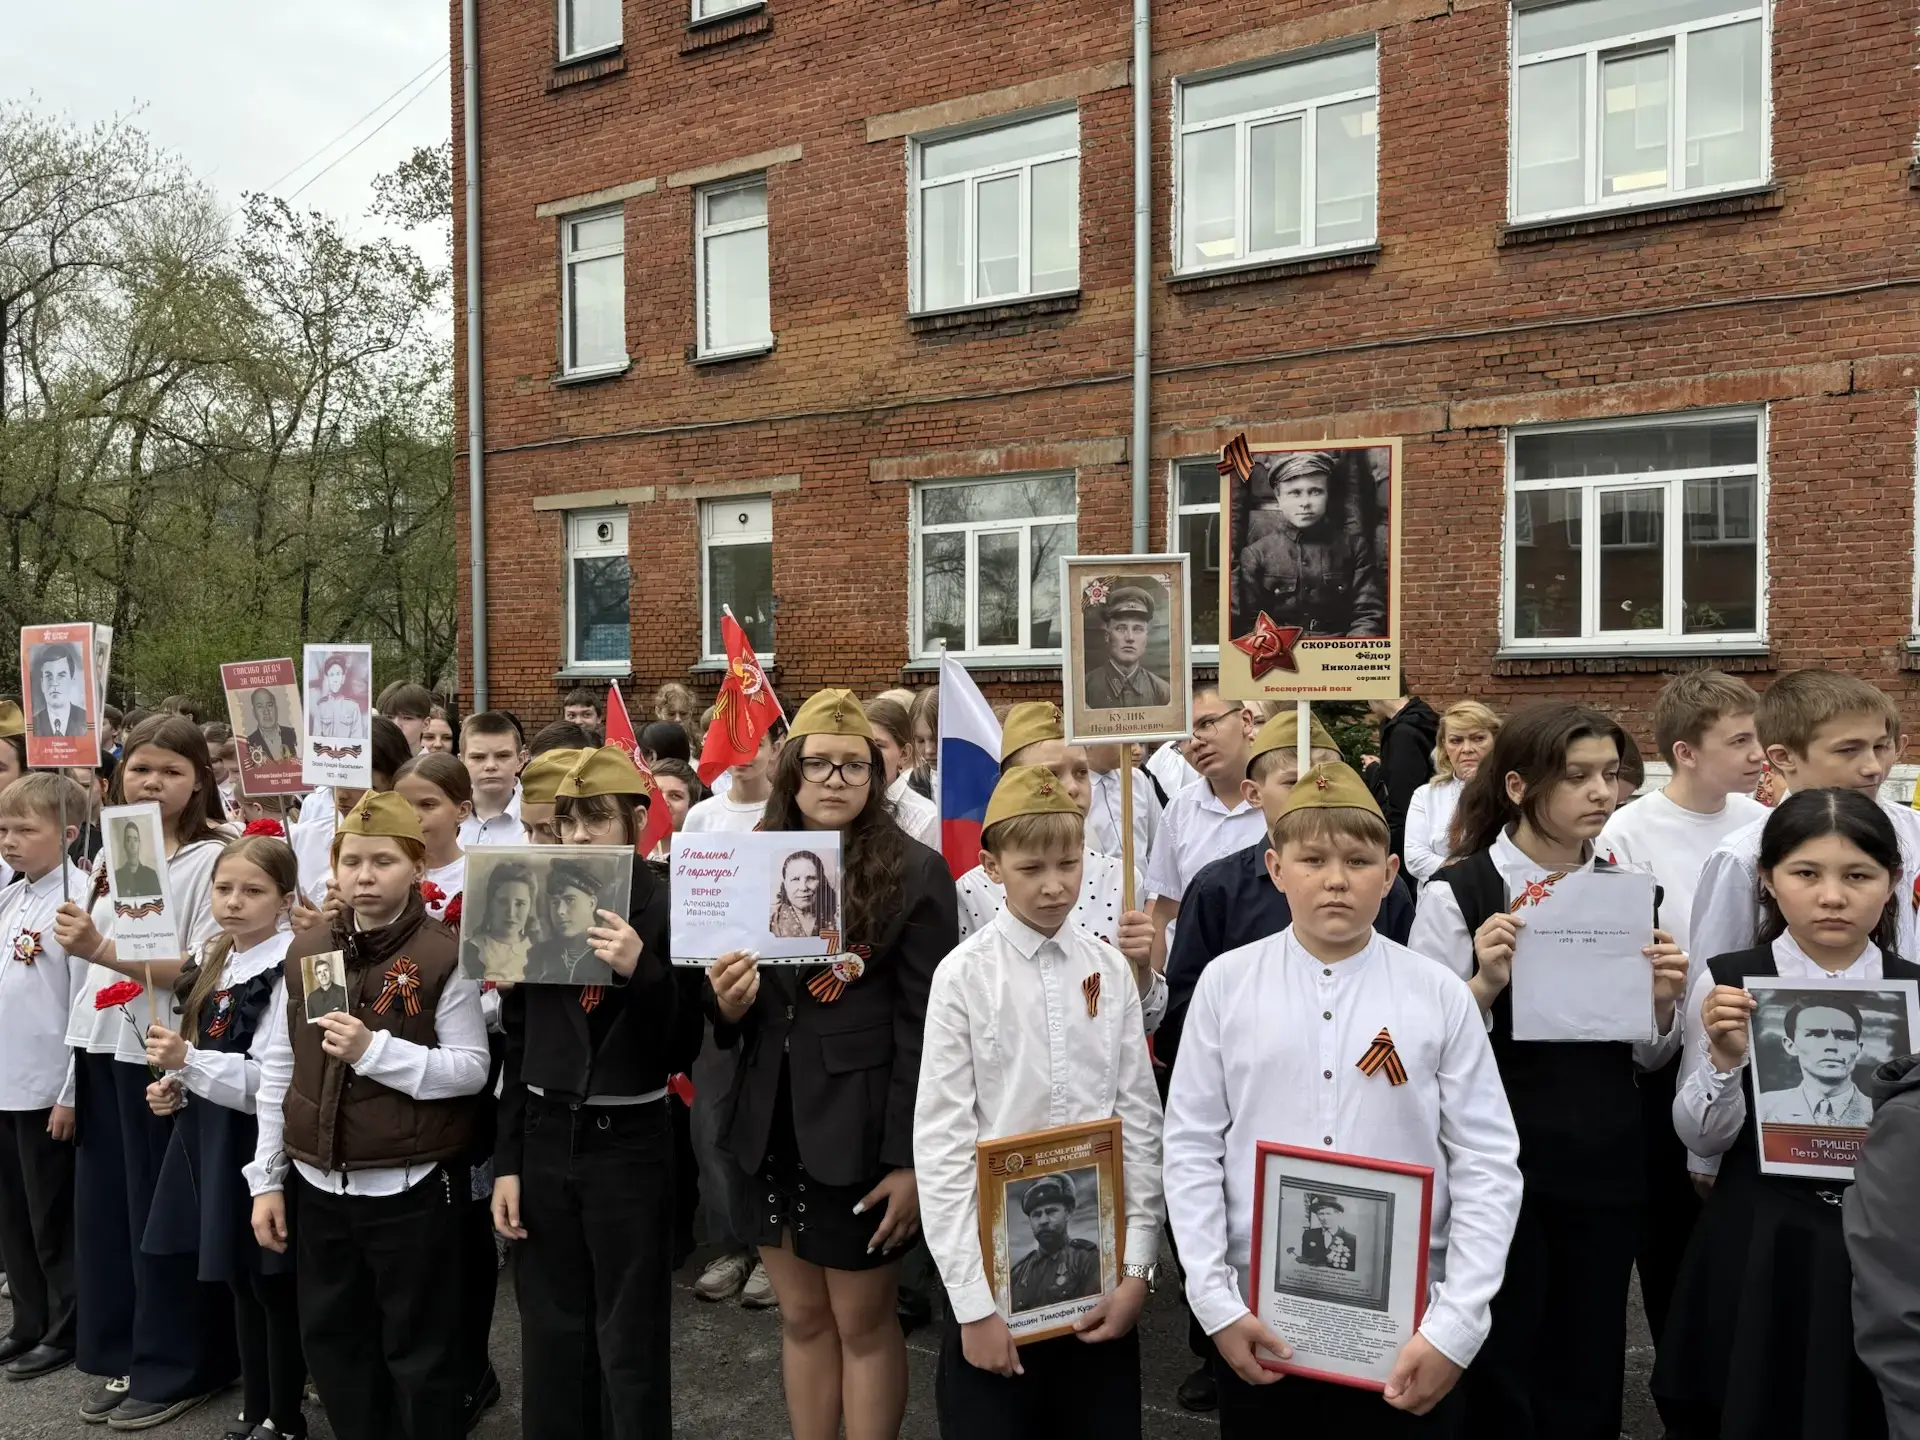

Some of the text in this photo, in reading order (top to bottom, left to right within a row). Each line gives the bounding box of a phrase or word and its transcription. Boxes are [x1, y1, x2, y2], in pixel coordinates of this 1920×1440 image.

[1301, 640, 1391, 649] СКОРОБОГАТОВ
[1355, 651, 1391, 660] Фёдор
[232, 663, 281, 675] СПАСИБО ДЕДУ
[1321, 663, 1391, 671] Николаевич
[240, 675, 278, 685] ЗА ПОБЕДУ!
[1264, 685, 1327, 693] Бессмертный
[1109, 711, 1145, 721] КУЛИК
[1115, 723, 1164, 731] Яковлевич
[680, 847, 736, 860] Я помню!
[676, 864, 739, 883] Я горжусь!
[691, 888, 722, 896] ВЕРНЕР
[683, 899, 730, 908] Александра
[686, 908, 726, 916] Ивановна
[1811, 1138, 1863, 1151] ПРИЩЕП
[1035, 1143, 1092, 1160] БЕССМЕРТНЫЙ
[1790, 1147, 1819, 1158] Петр
[1037, 1150, 1091, 1166] ПОЛК РОССИИ
[1040, 1307, 1076, 1322] Тимофей
